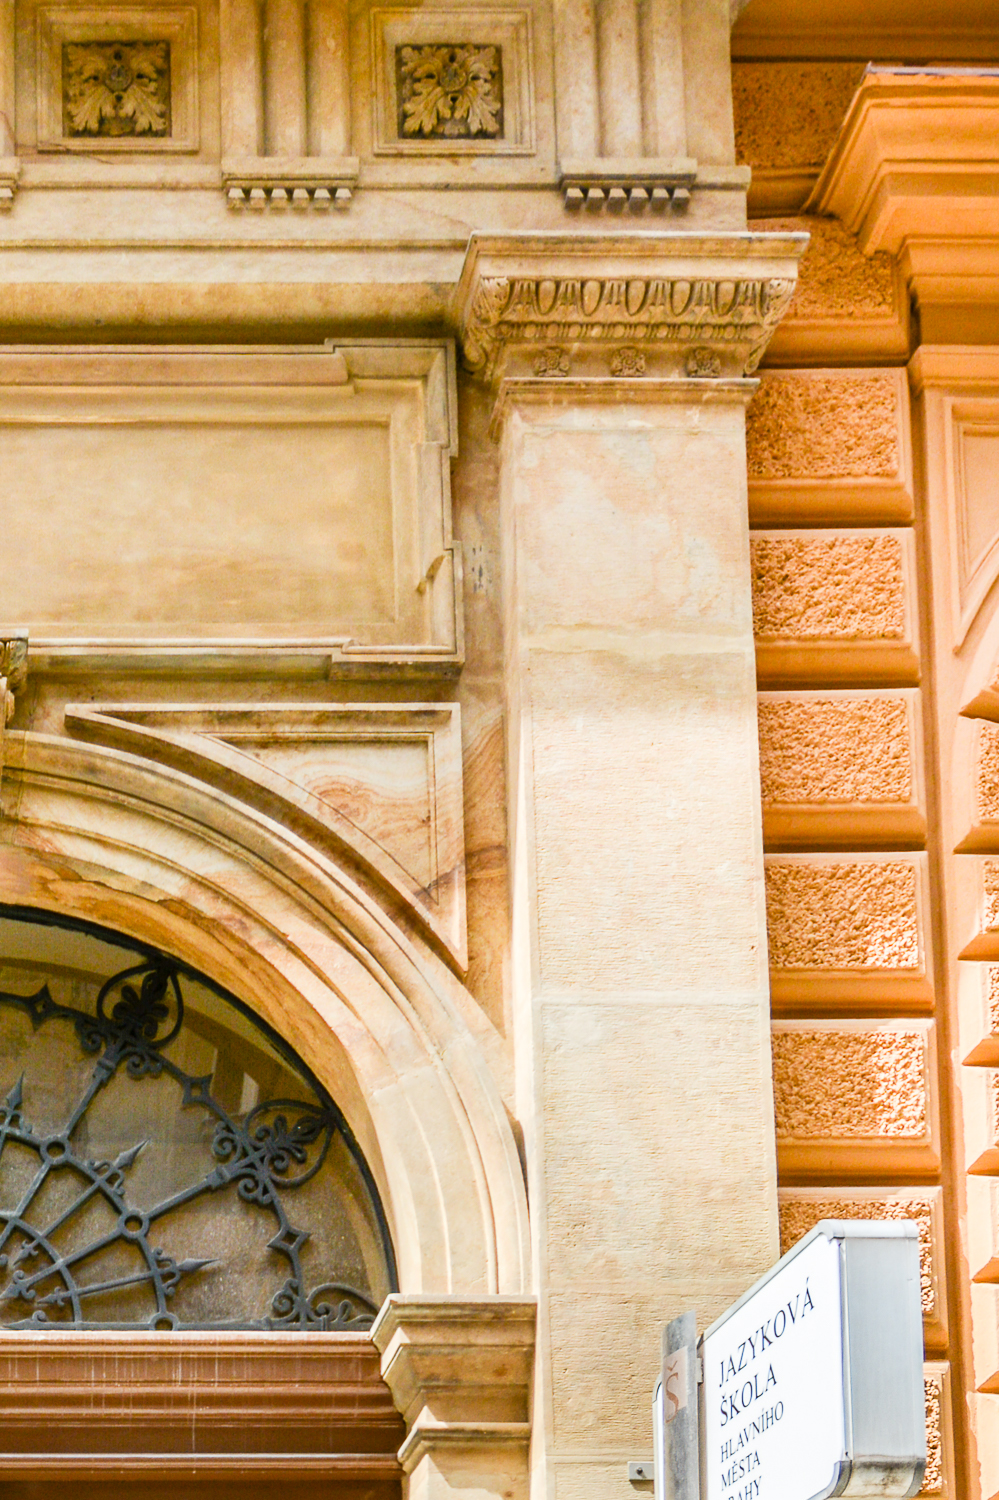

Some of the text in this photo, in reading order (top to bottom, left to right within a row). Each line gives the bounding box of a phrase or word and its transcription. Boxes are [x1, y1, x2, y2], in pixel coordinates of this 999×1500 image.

[719, 1276, 815, 1388] JAZYKOVÁ
[720, 1362, 778, 1427] ŠKOLA
[720, 1400, 784, 1464] HLAVNÍHO
[720, 1449, 761, 1492] MĚSTA
